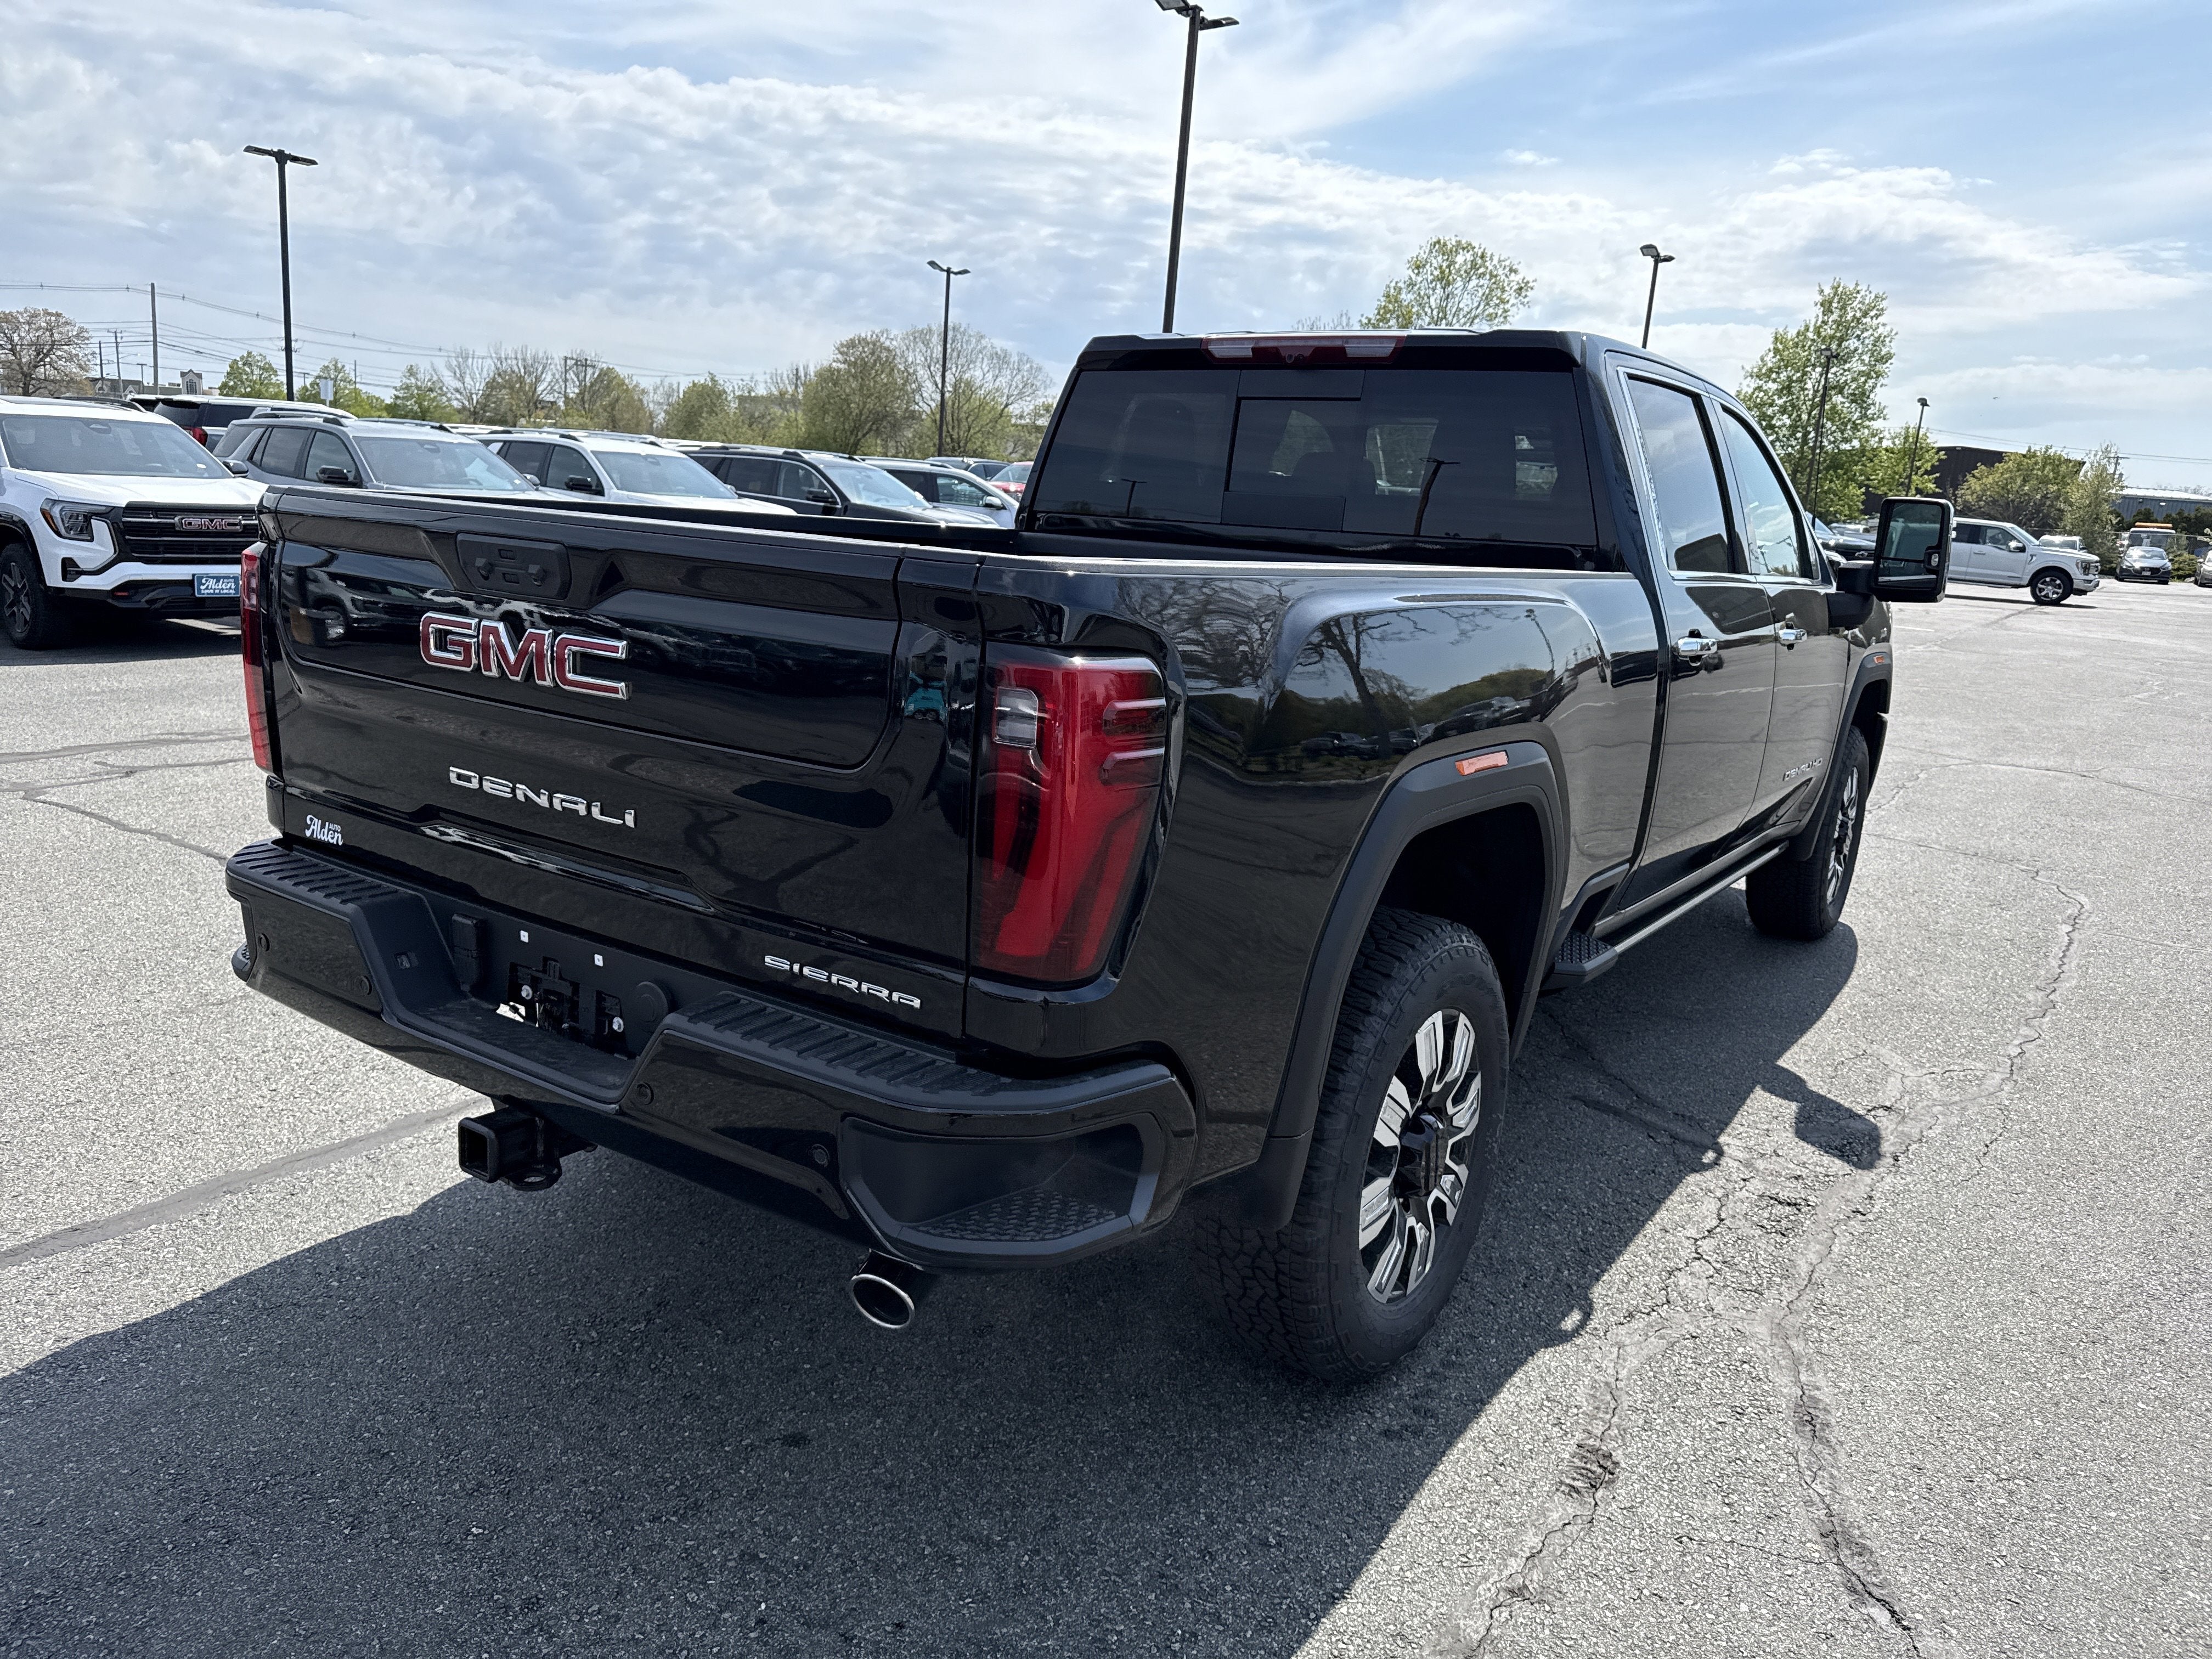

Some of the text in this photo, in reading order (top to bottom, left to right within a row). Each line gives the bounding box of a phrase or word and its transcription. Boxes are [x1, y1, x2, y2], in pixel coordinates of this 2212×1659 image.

[182, 518, 240, 530] GMC
[200, 577, 236, 589] Alden
[420, 611, 631, 701] GMC
[1782, 758, 1823, 781] DENALI HD
[449, 766, 635, 828] DENALI
[305, 814, 344, 845] Alden
[329, 822, 341, 832] AUTO
[765, 955, 921, 1009] SIERRA
